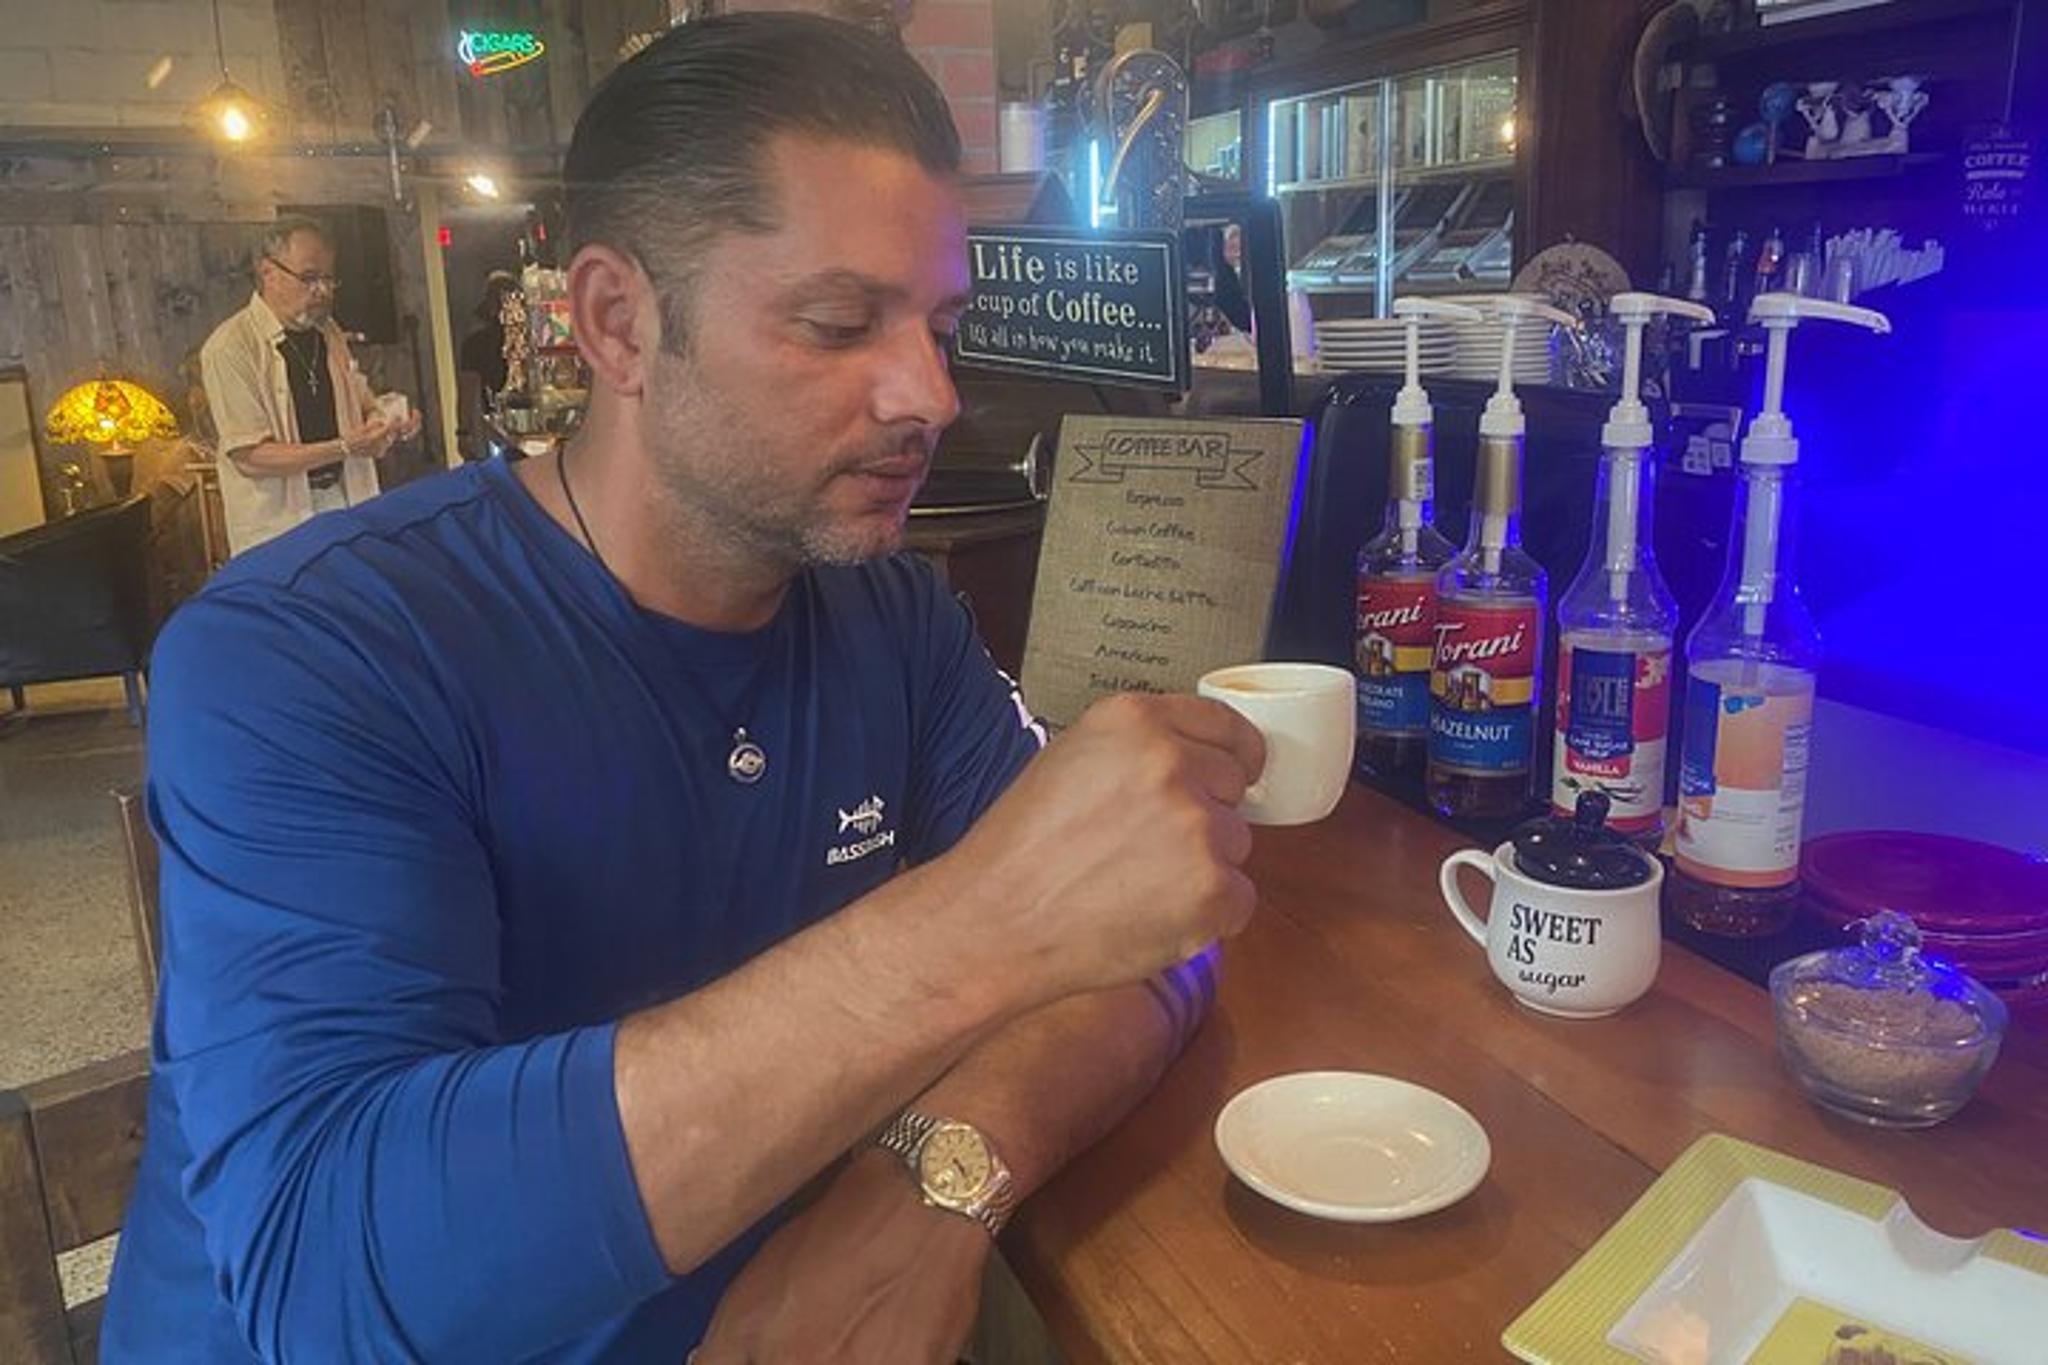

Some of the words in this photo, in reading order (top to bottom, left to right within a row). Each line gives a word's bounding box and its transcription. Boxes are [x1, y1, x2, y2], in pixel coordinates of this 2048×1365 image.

[469, 32, 534, 52] CIGARS
[974, 243, 1045, 284] Life
[1055, 252, 1079, 280] is
[1085, 252, 1139, 284] like
[977, 294, 1014, 318] cup
[1018, 291, 1041, 316] of
[1046, 288, 1162, 330] Coffee...
[990, 324, 1008, 348] all
[1012, 327, 1026, 348] in
[1029, 326, 1058, 351] how
[1060, 339, 1090, 361] you
[1094, 332, 1134, 362] make
[1108, 436, 1172, 456] COFFEE
[1177, 437, 1224, 458] BAR
[1126, 489, 1185, 510] Espresso
[1150, 522, 1197, 541] Coffee
[1433, 622, 1526, 670] Torani
[1430, 715, 1512, 742] HAZELNUT
[1572, 760, 1620, 775] VANILLA
[1510, 903, 1602, 945] SWEET
[1507, 934, 1537, 964] AS
[1518, 969, 1586, 995] sugar
